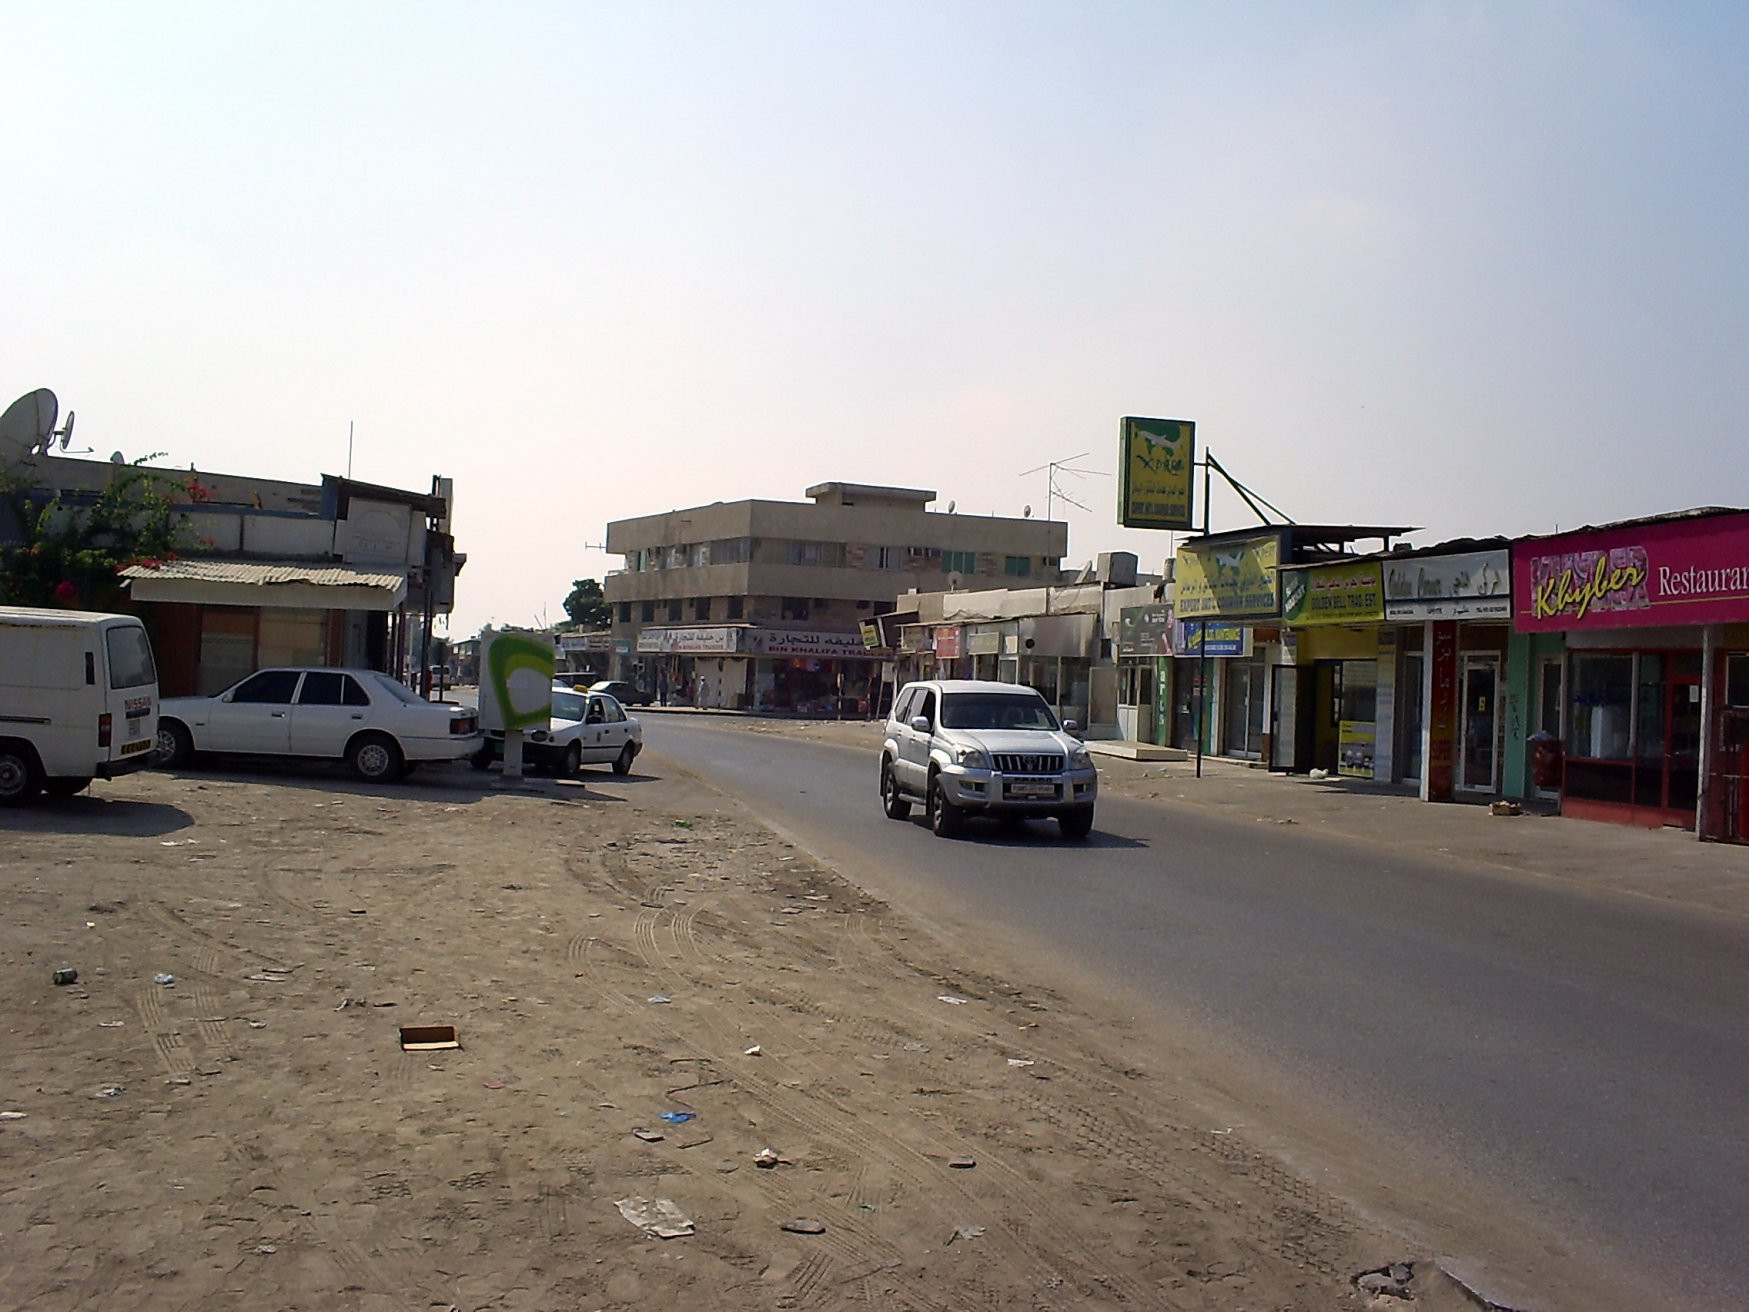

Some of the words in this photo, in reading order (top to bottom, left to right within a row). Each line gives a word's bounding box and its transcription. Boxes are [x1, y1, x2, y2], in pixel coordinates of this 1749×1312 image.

[1536, 555, 1645, 620] Khyber
[768, 645, 788, 653] BIN
[791, 646, 838, 655] KHALIFA
[124, 696, 152, 710] NISSAN
